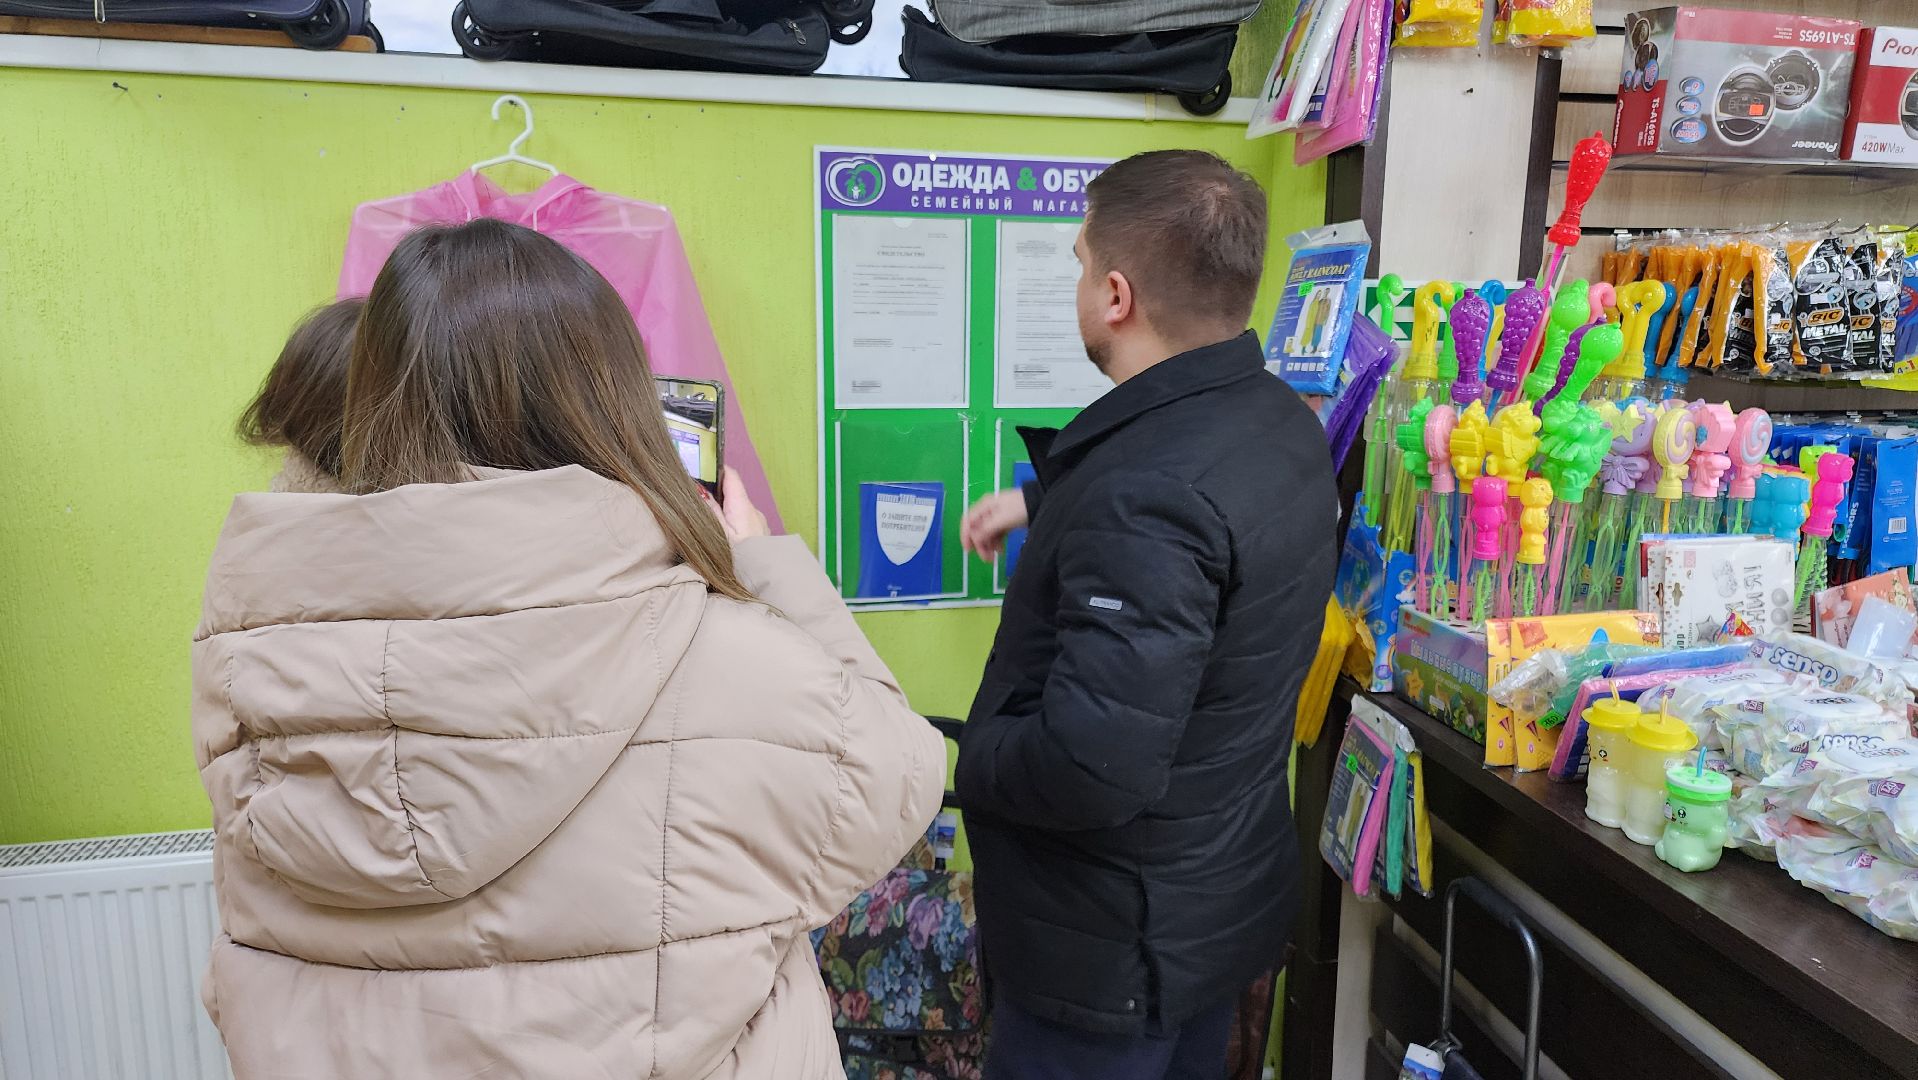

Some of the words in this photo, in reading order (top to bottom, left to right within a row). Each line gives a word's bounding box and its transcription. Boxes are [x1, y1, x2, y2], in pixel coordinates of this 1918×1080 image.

[1800, 30, 1856, 46] TS-A1695S
[1652, 96, 1661, 147] TS-A1695S
[1792, 140, 1839, 153] Pioneer
[892, 162, 1011, 194] ОДЕЖДА
[1016, 167, 1037, 191] &
[1042, 167, 1104, 193] ОБУ
[910, 195, 1013, 211] СЕМЕЙНЫЙ
[1033, 199, 1090, 213] МАГАЗ
[1801, 324, 1847, 339] METAL
[1852, 330, 1875, 341] TAL
[1769, 646, 1839, 684] senso
[1817, 734, 1885, 753] senso
